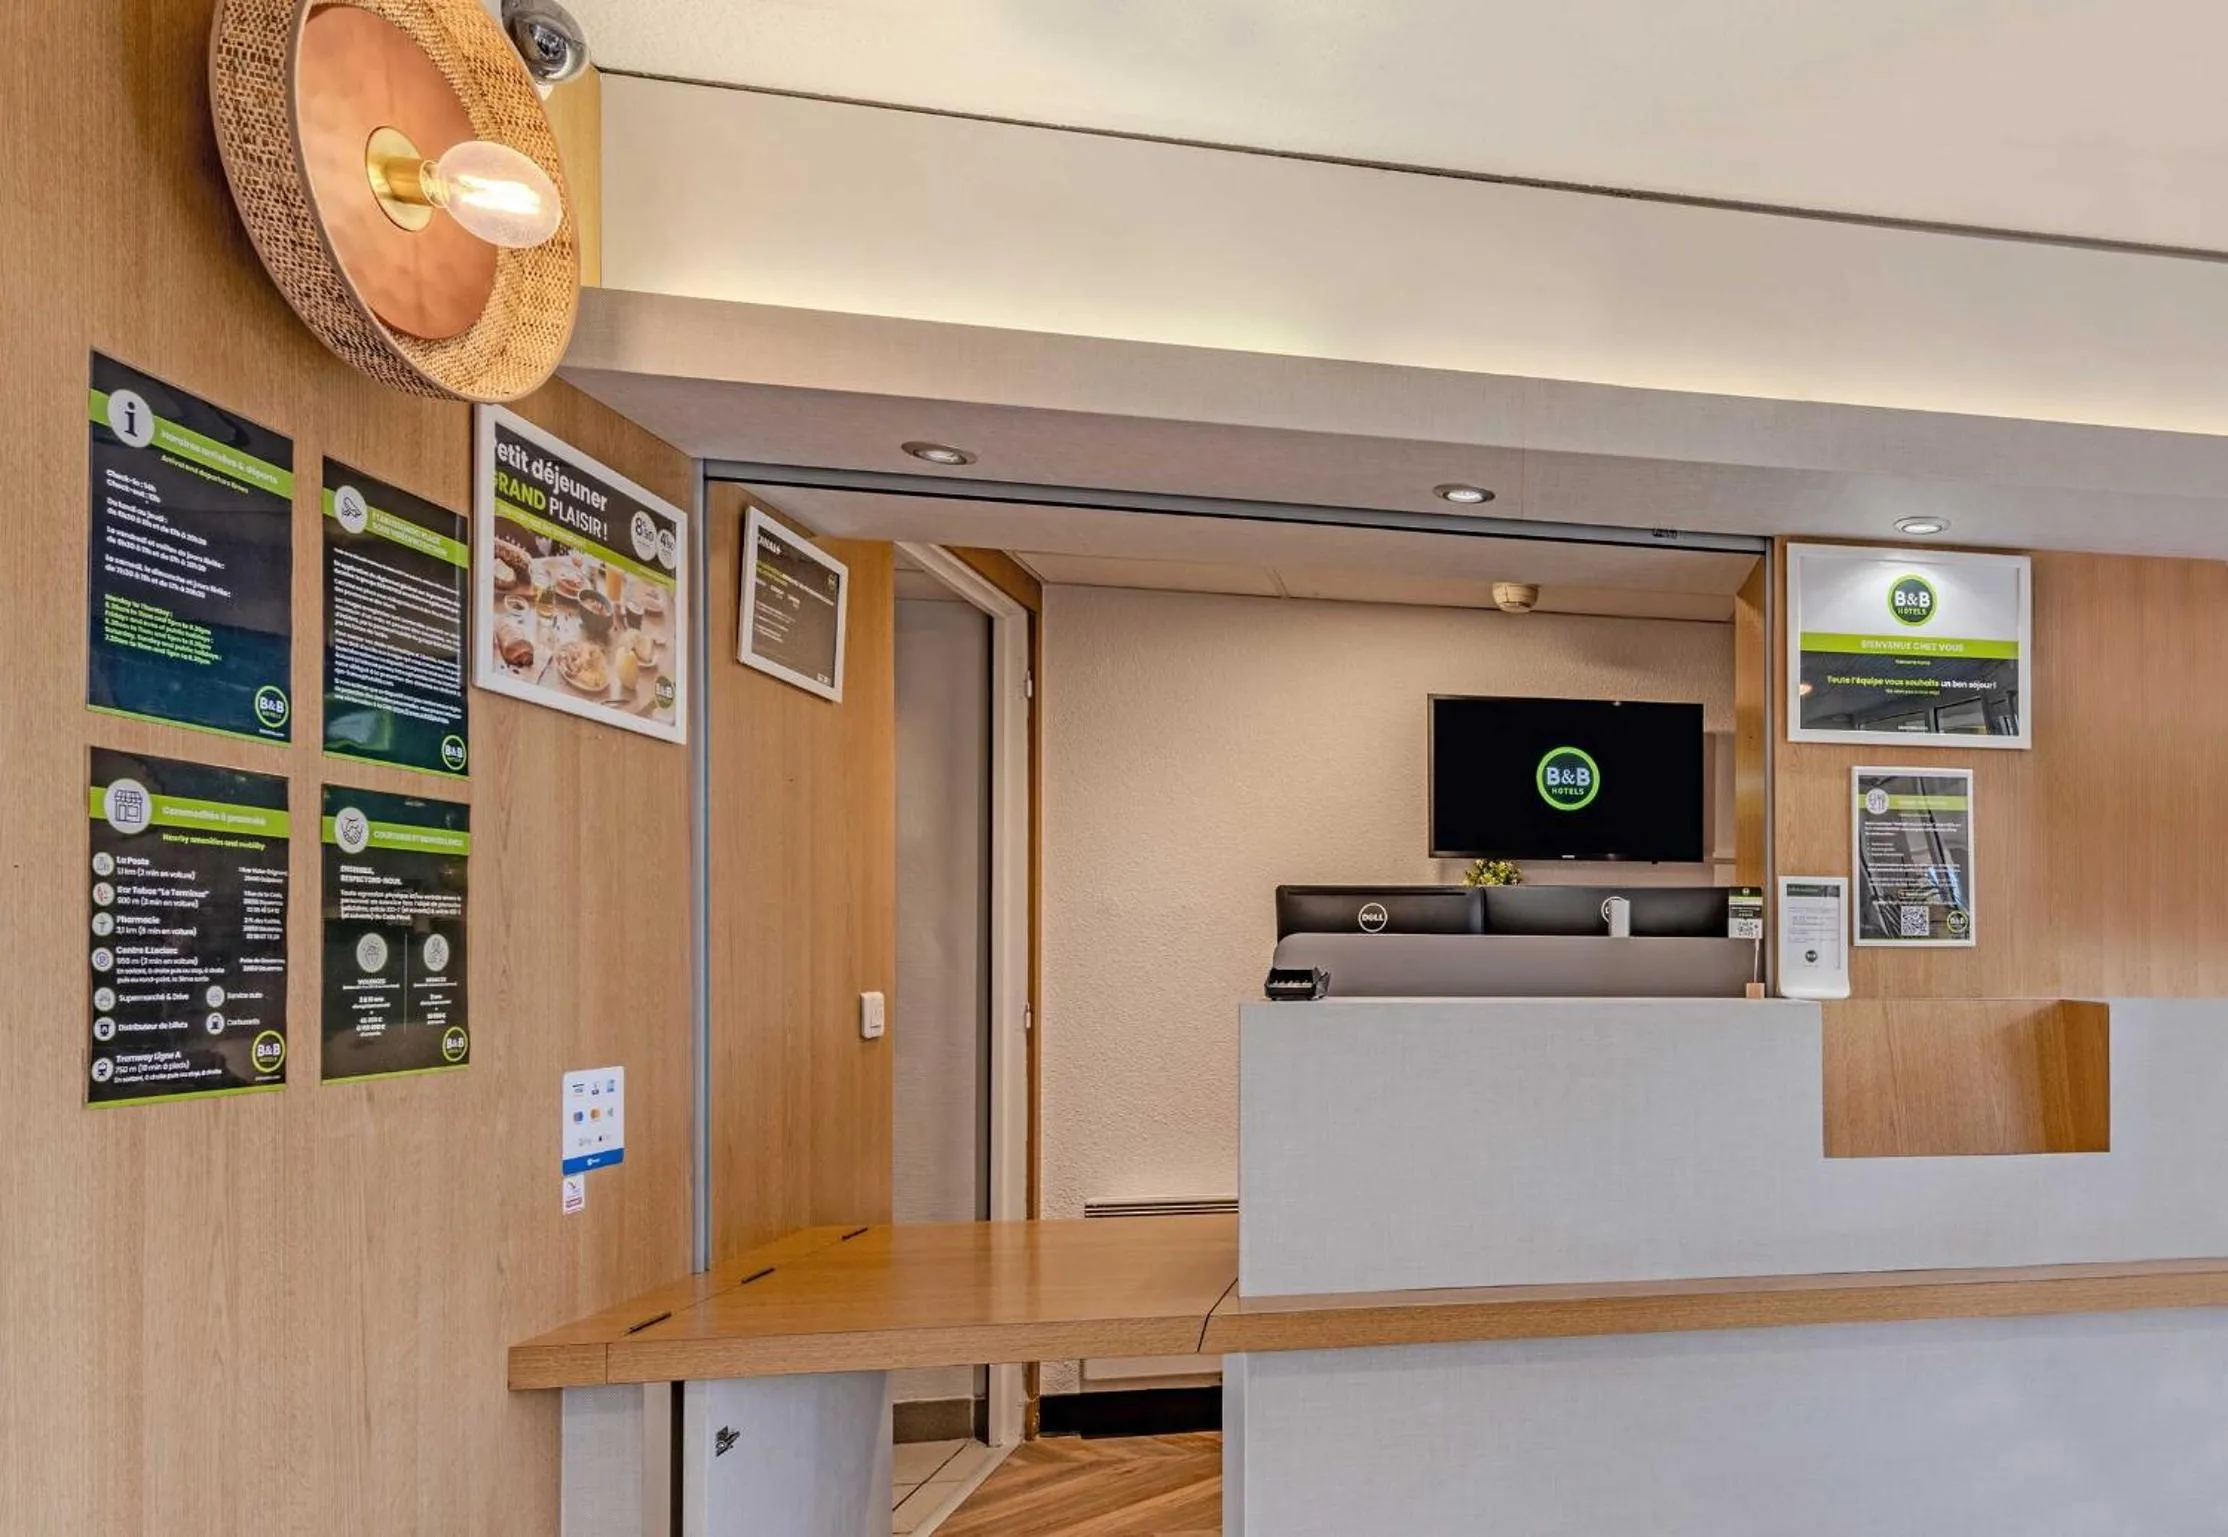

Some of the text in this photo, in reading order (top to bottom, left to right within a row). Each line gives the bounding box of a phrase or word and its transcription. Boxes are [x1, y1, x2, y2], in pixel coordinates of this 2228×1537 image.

[494, 440, 608, 512] etit déjeuner
[550, 497, 601, 537] PLAISIR
[1894, 590, 1931, 608] B&B
[1898, 608, 1927, 616] HOTELS
[1861, 640, 1964, 652] BIENVENUE CHEZ VOUS
[1827, 676, 1850, 684] Toute
[1850, 676, 1884, 687] l'équipe
[1905, 678, 1939, 686] souhaite
[1952, 680, 1968, 688] bon
[260, 697, 284, 714] B&B
[444, 744, 462, 758] B&B
[1546, 767, 1590, 786] B&B
[1552, 787, 1584, 796] HOTELS
[128, 857, 150, 865] Poste
[116, 916, 160, 924] Pharmacie
[1362, 913, 1384, 921] DELL
[116, 946, 144, 954] Centre
[257, 1043, 280, 1056] B&B
[116, 1054, 154, 1062] Tramway
